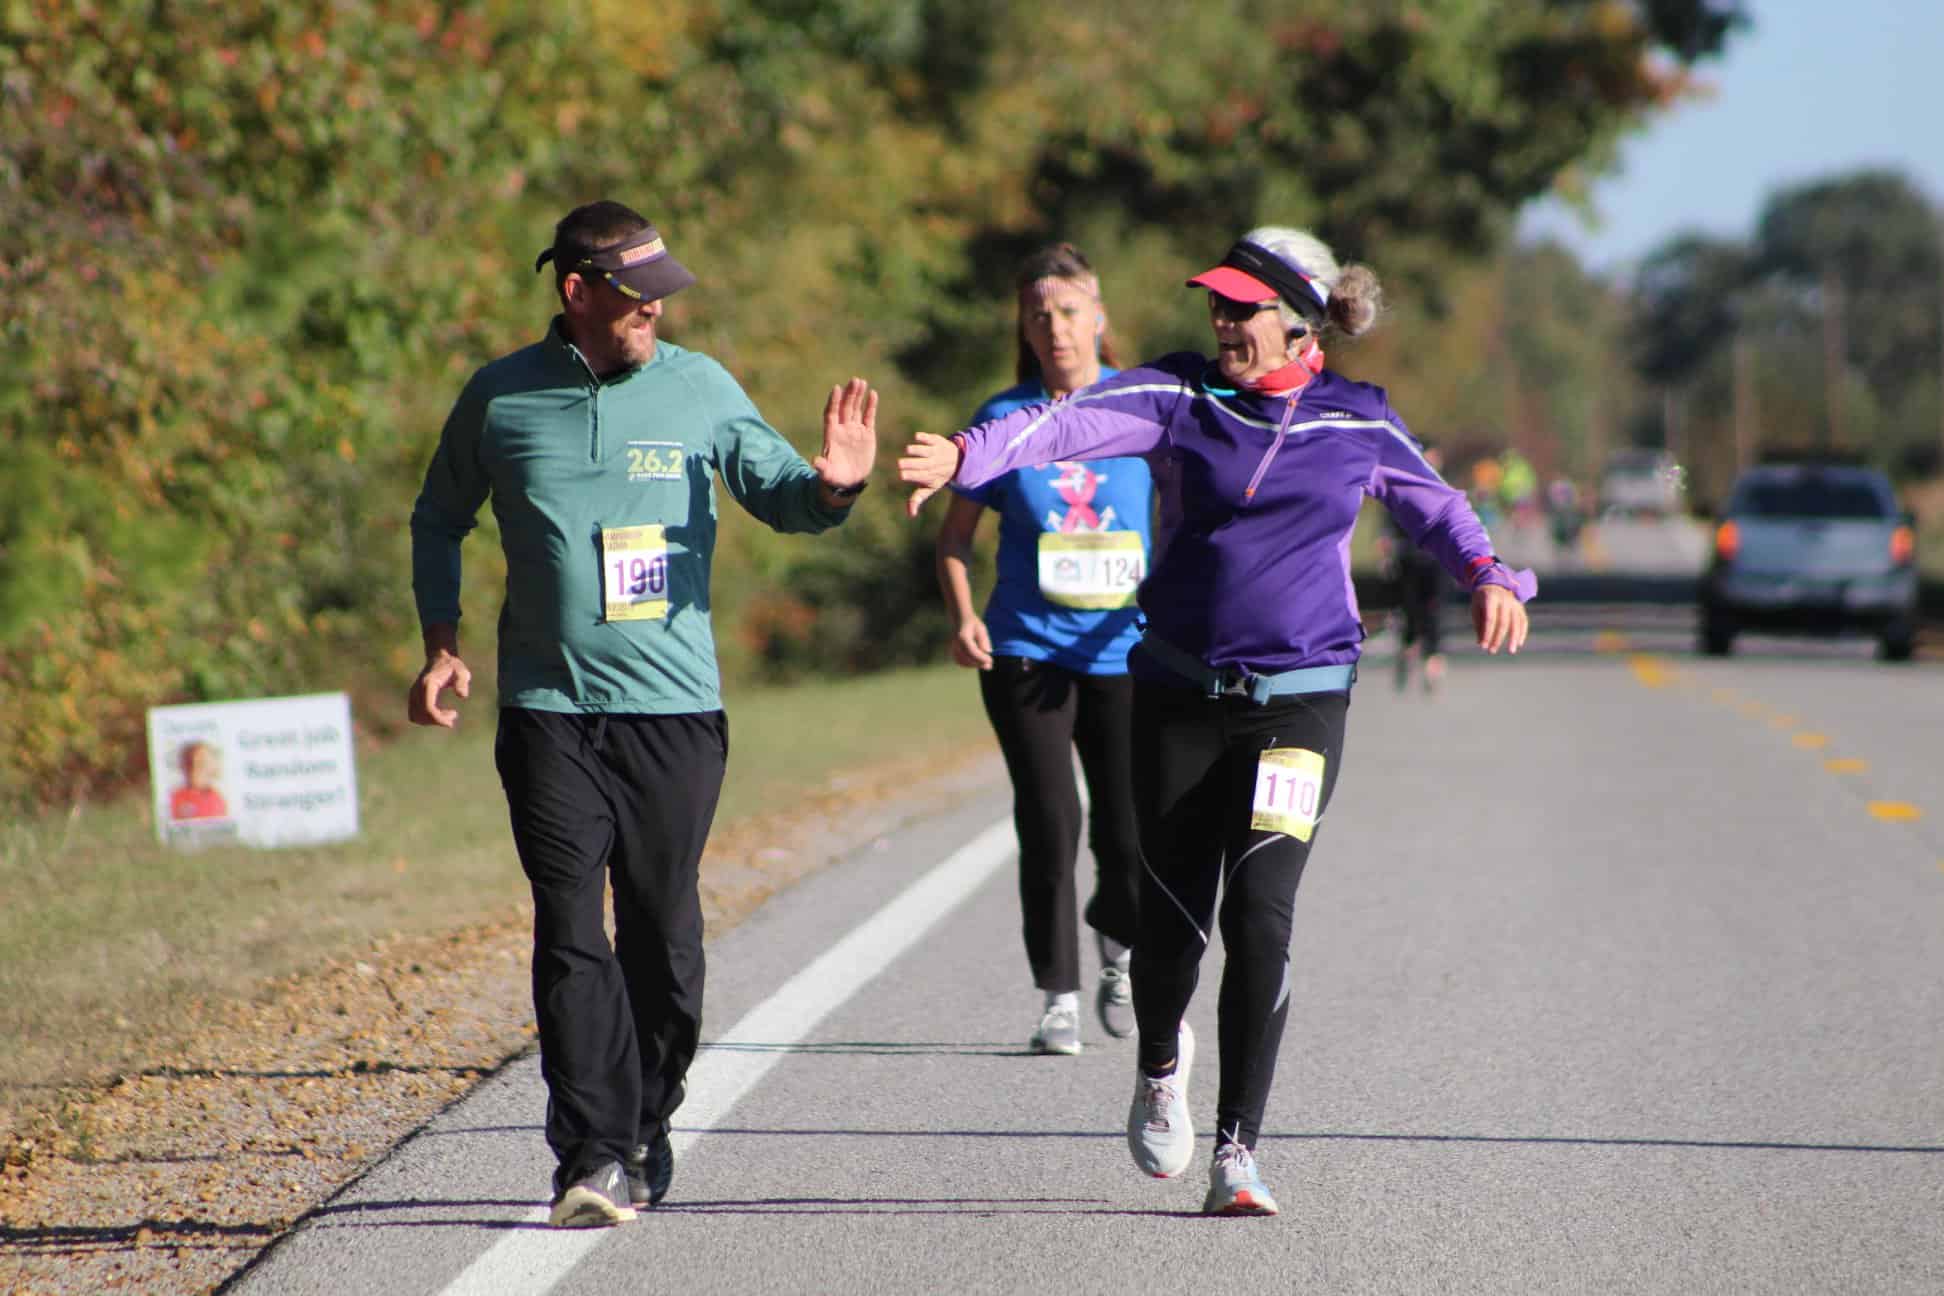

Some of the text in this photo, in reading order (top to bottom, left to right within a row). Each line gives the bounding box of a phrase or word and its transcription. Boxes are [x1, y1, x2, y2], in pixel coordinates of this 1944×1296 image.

[627, 448, 684, 474] 26.2
[614, 557, 665, 597] 190
[1104, 558, 1141, 587] 124
[1266, 773, 1317, 817] 110
